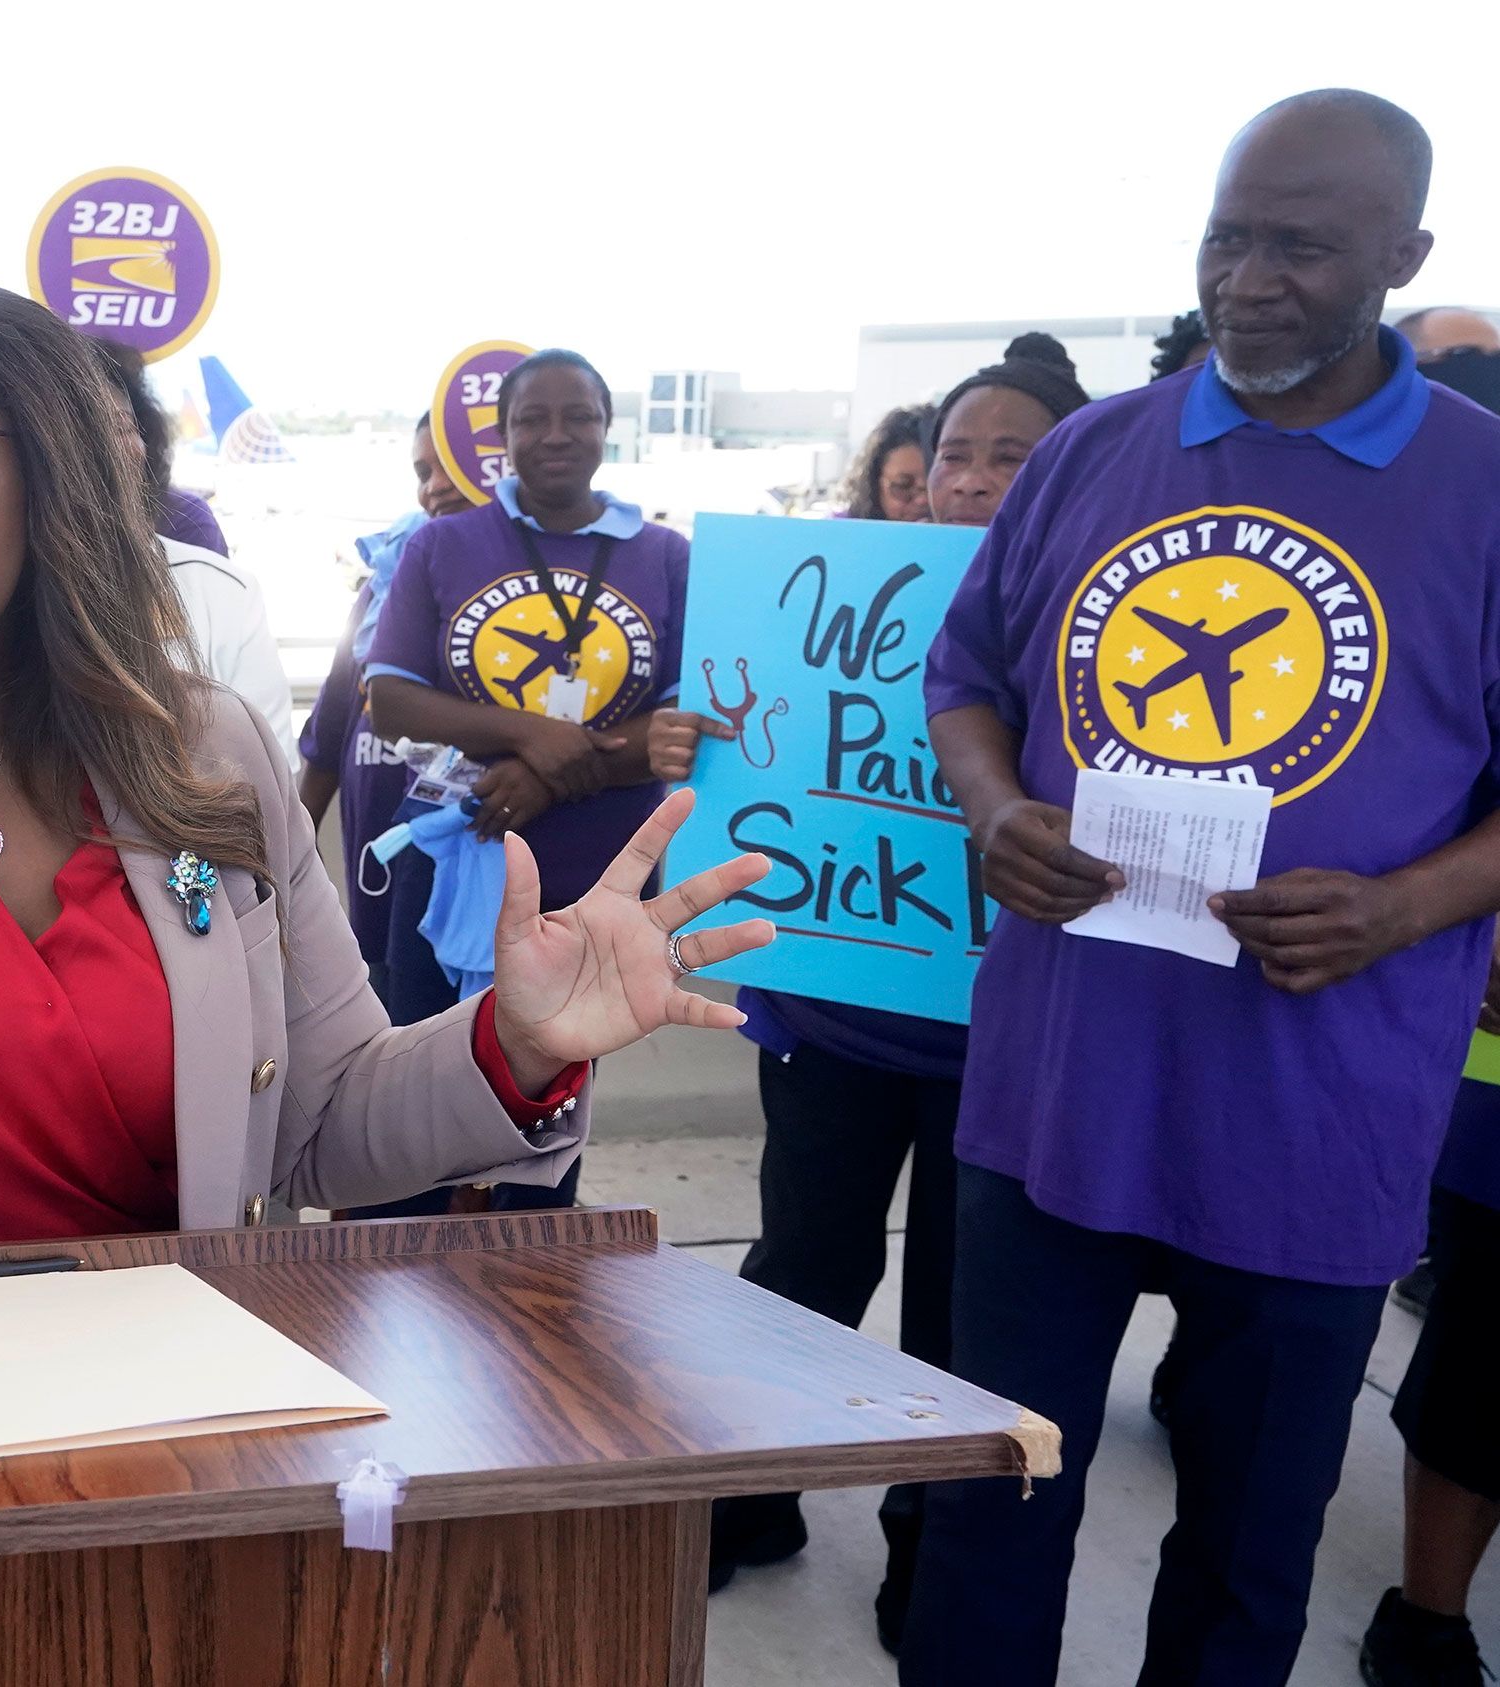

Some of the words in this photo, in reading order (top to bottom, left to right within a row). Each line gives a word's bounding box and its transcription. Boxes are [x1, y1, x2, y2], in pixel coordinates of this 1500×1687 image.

[68, 200, 180, 237] 32BJ
[68, 294, 177, 328] SEIU
[461, 371, 508, 406] 32
[450, 575, 539, 668] AIRPORT
[779, 555, 925, 684] We
[1070, 520, 1218, 659] AIRPORT
[1233, 520, 1371, 703] WORKERS
[725, 803, 954, 932] Sick
